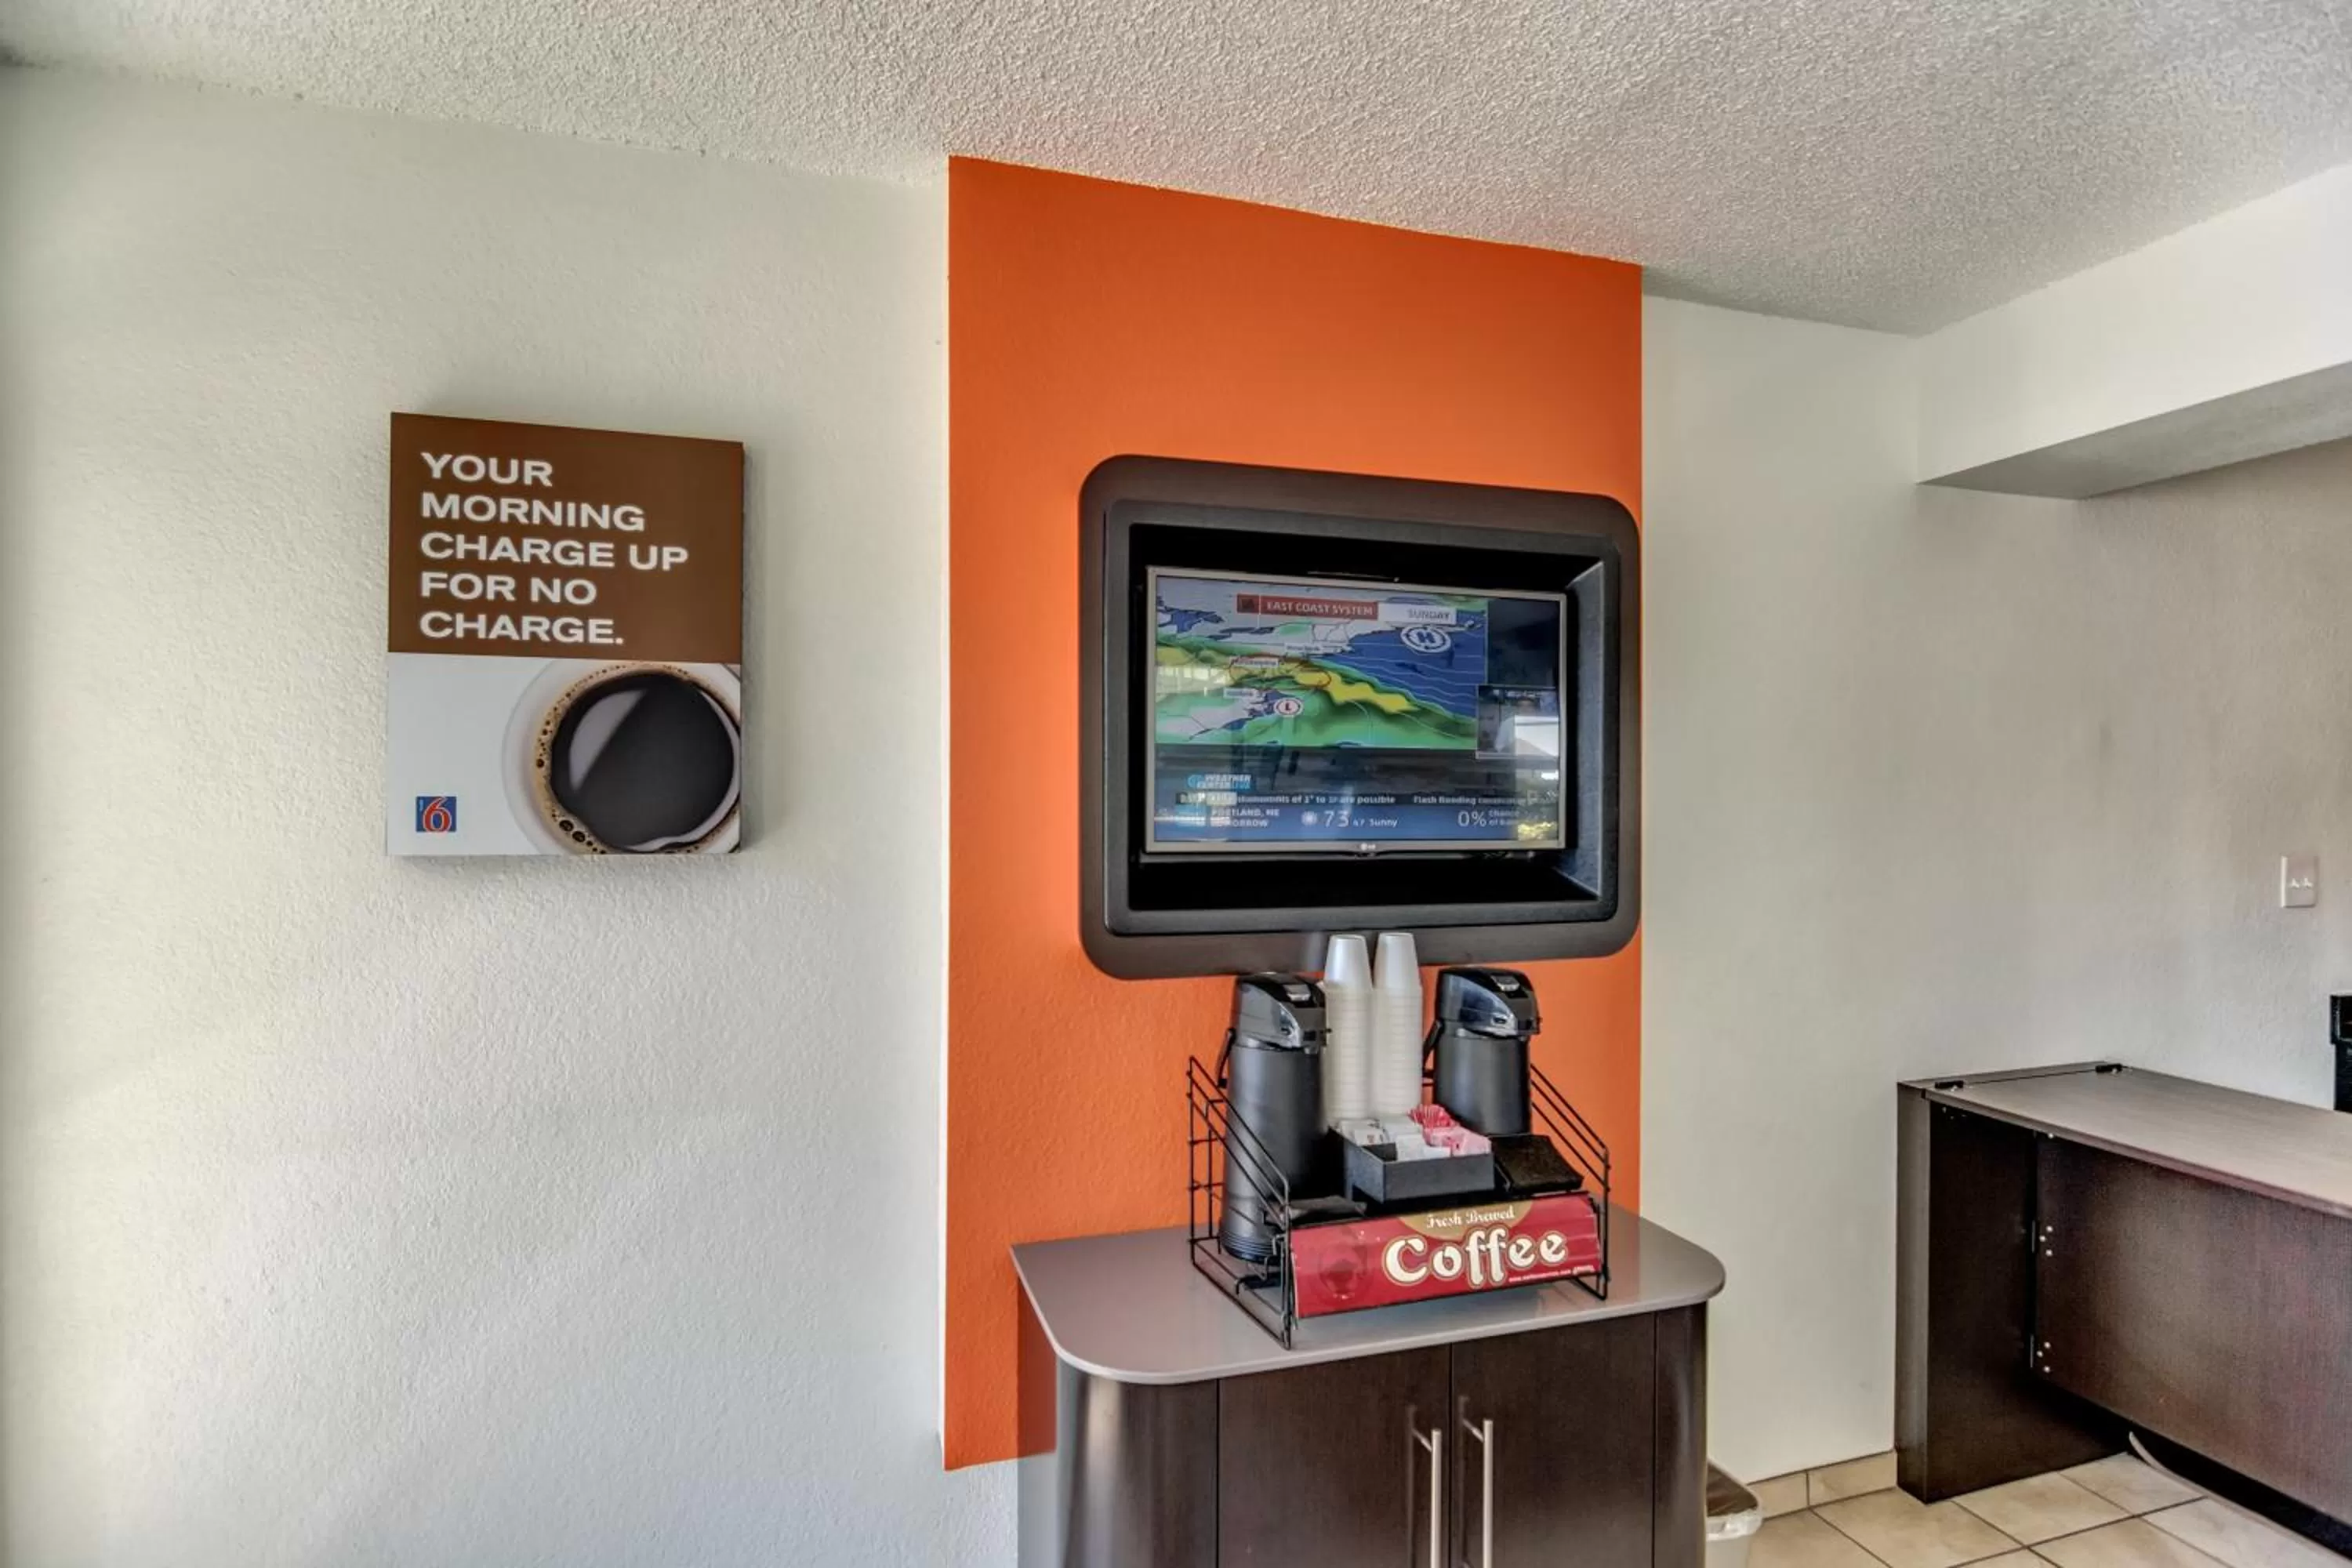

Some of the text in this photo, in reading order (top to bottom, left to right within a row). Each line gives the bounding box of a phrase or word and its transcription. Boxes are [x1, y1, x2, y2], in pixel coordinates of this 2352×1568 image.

[422, 452, 553, 486] YOUR
[423, 492, 644, 531] MORNING
[421, 532, 688, 571] CHARGE UP
[422, 572, 597, 604] FOR NO
[1266, 601, 1373, 615] EAST COAST SYSTEM
[1409, 609, 1450, 620] SUNDAY
[420, 612, 623, 644] CHARGE.
[1316, 794, 1326, 804] to
[1356, 794, 1396, 804] possible
[1413, 795, 1437, 804] Flash
[422, 796, 452, 833] 6
[1323, 810, 1350, 828] 73
[1369, 818, 1399, 828] Sunny
[1457, 810, 1487, 827] 0%
[1426, 1204, 1515, 1229] Fresh Brewed
[1384, 1226, 1566, 1286] Coffee
